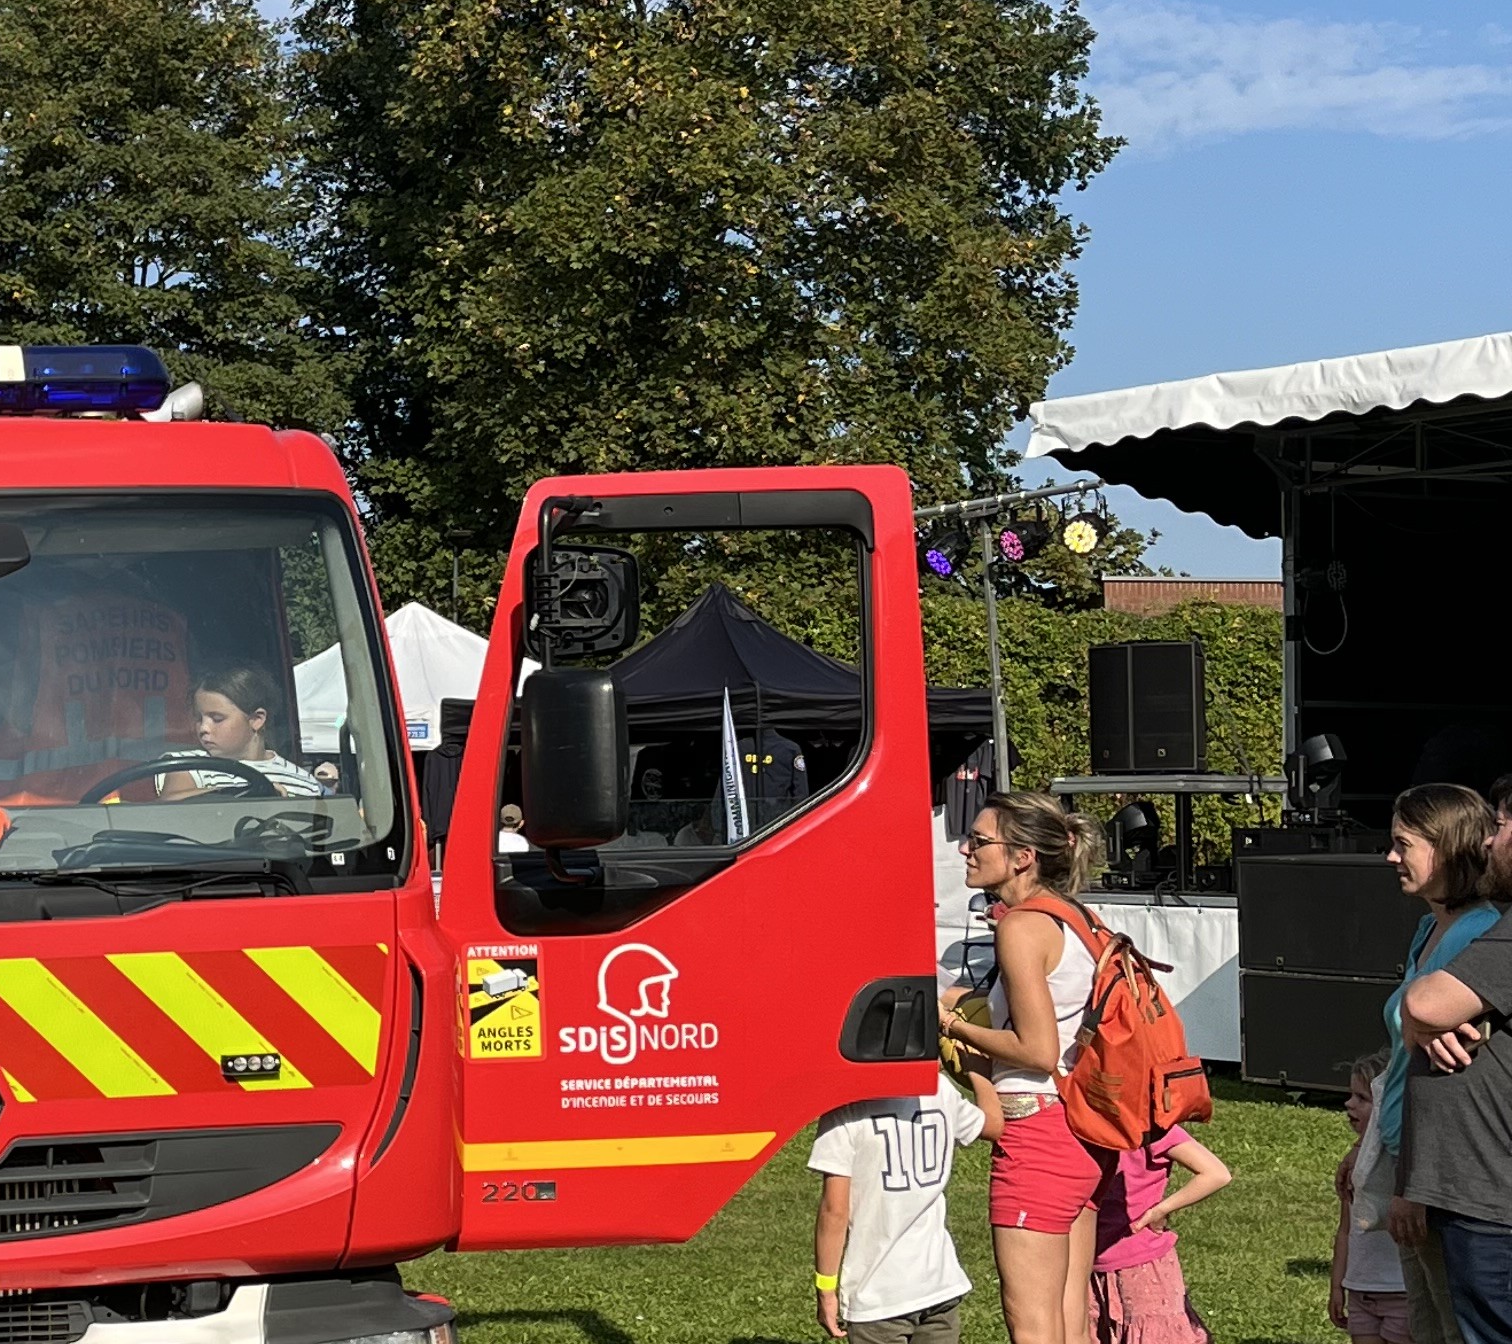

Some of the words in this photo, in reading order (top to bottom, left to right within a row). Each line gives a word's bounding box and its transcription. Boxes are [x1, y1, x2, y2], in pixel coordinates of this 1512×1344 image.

[467, 945, 538, 958] ATTENTION
[478, 1025, 534, 1039] ANGLES
[640, 1023, 719, 1051] NORD
[481, 1039, 532, 1052] MORTS
[560, 1078, 611, 1091] SERVICE
[630, 1095, 644, 1106] ET
[647, 1094, 663, 1106] DE
[666, 1092, 719, 1105] SECOURS
[872, 1109, 948, 1193] 10
[482, 1181, 538, 1204] 220
